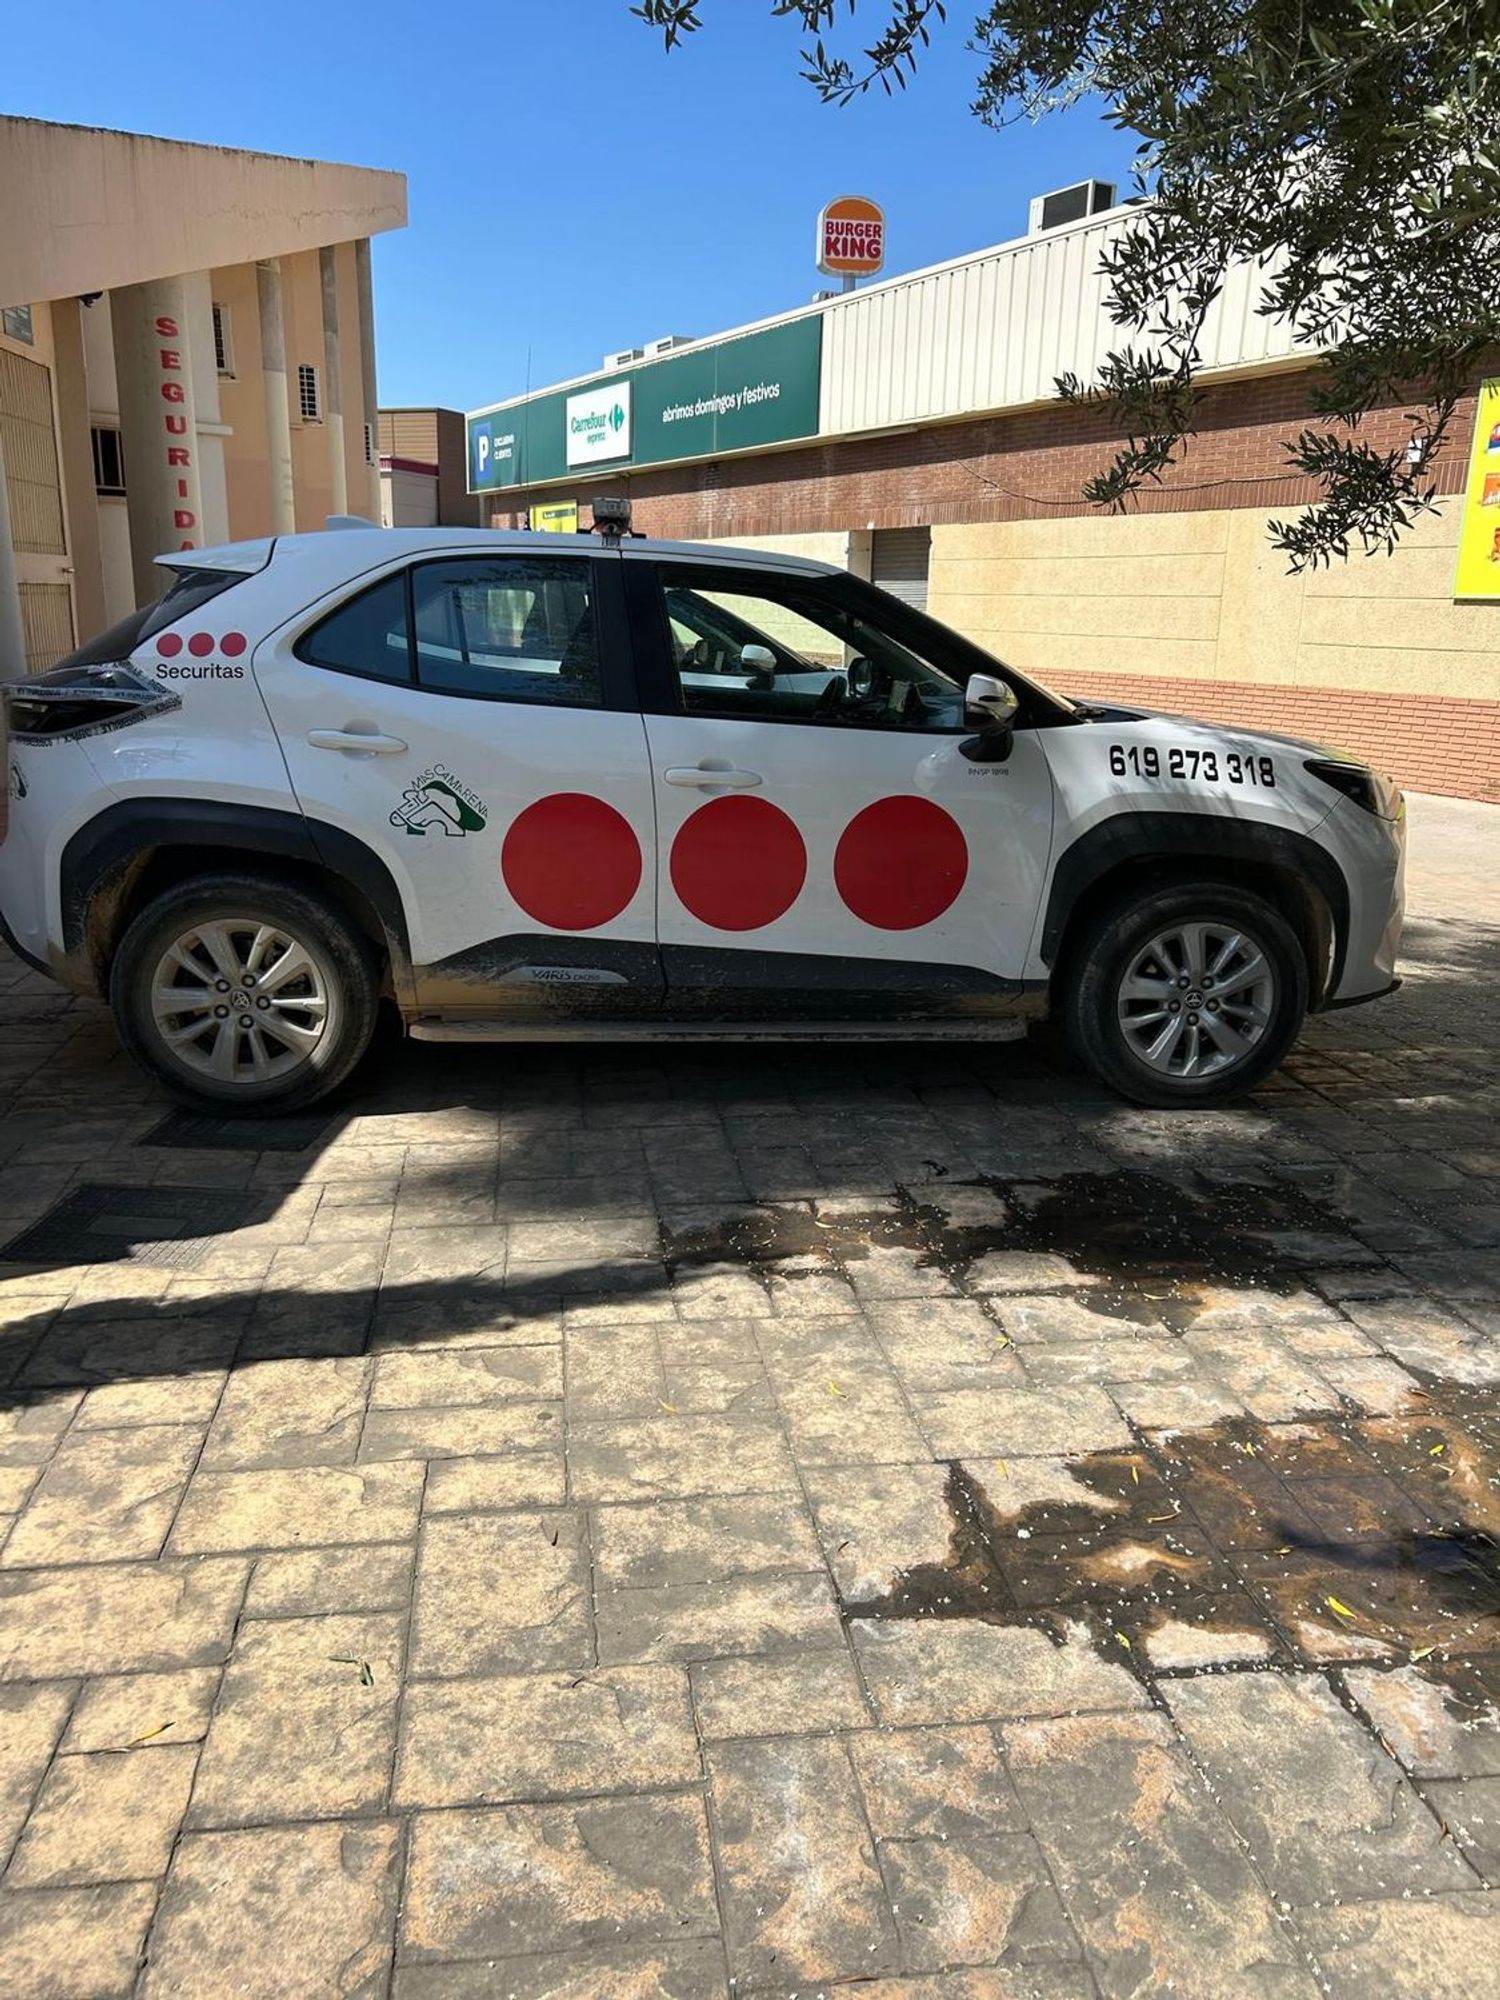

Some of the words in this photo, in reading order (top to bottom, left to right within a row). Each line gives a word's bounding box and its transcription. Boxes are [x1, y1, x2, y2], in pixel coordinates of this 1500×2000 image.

[825, 221, 882, 239] BURGER
[825, 237, 881, 259] KING
[662, 403, 695, 422] abrimos
[694, 395, 736, 414] domingos
[736, 391, 743, 410] y
[742, 382, 780, 405] festivos
[570, 411, 607, 434] Carrefour
[478, 435, 489, 472] P
[156, 663, 244, 679] Securitas
[1109, 745, 1160, 777] 619
[1168, 749, 1219, 781] 273
[1227, 754, 1275, 787] 318
